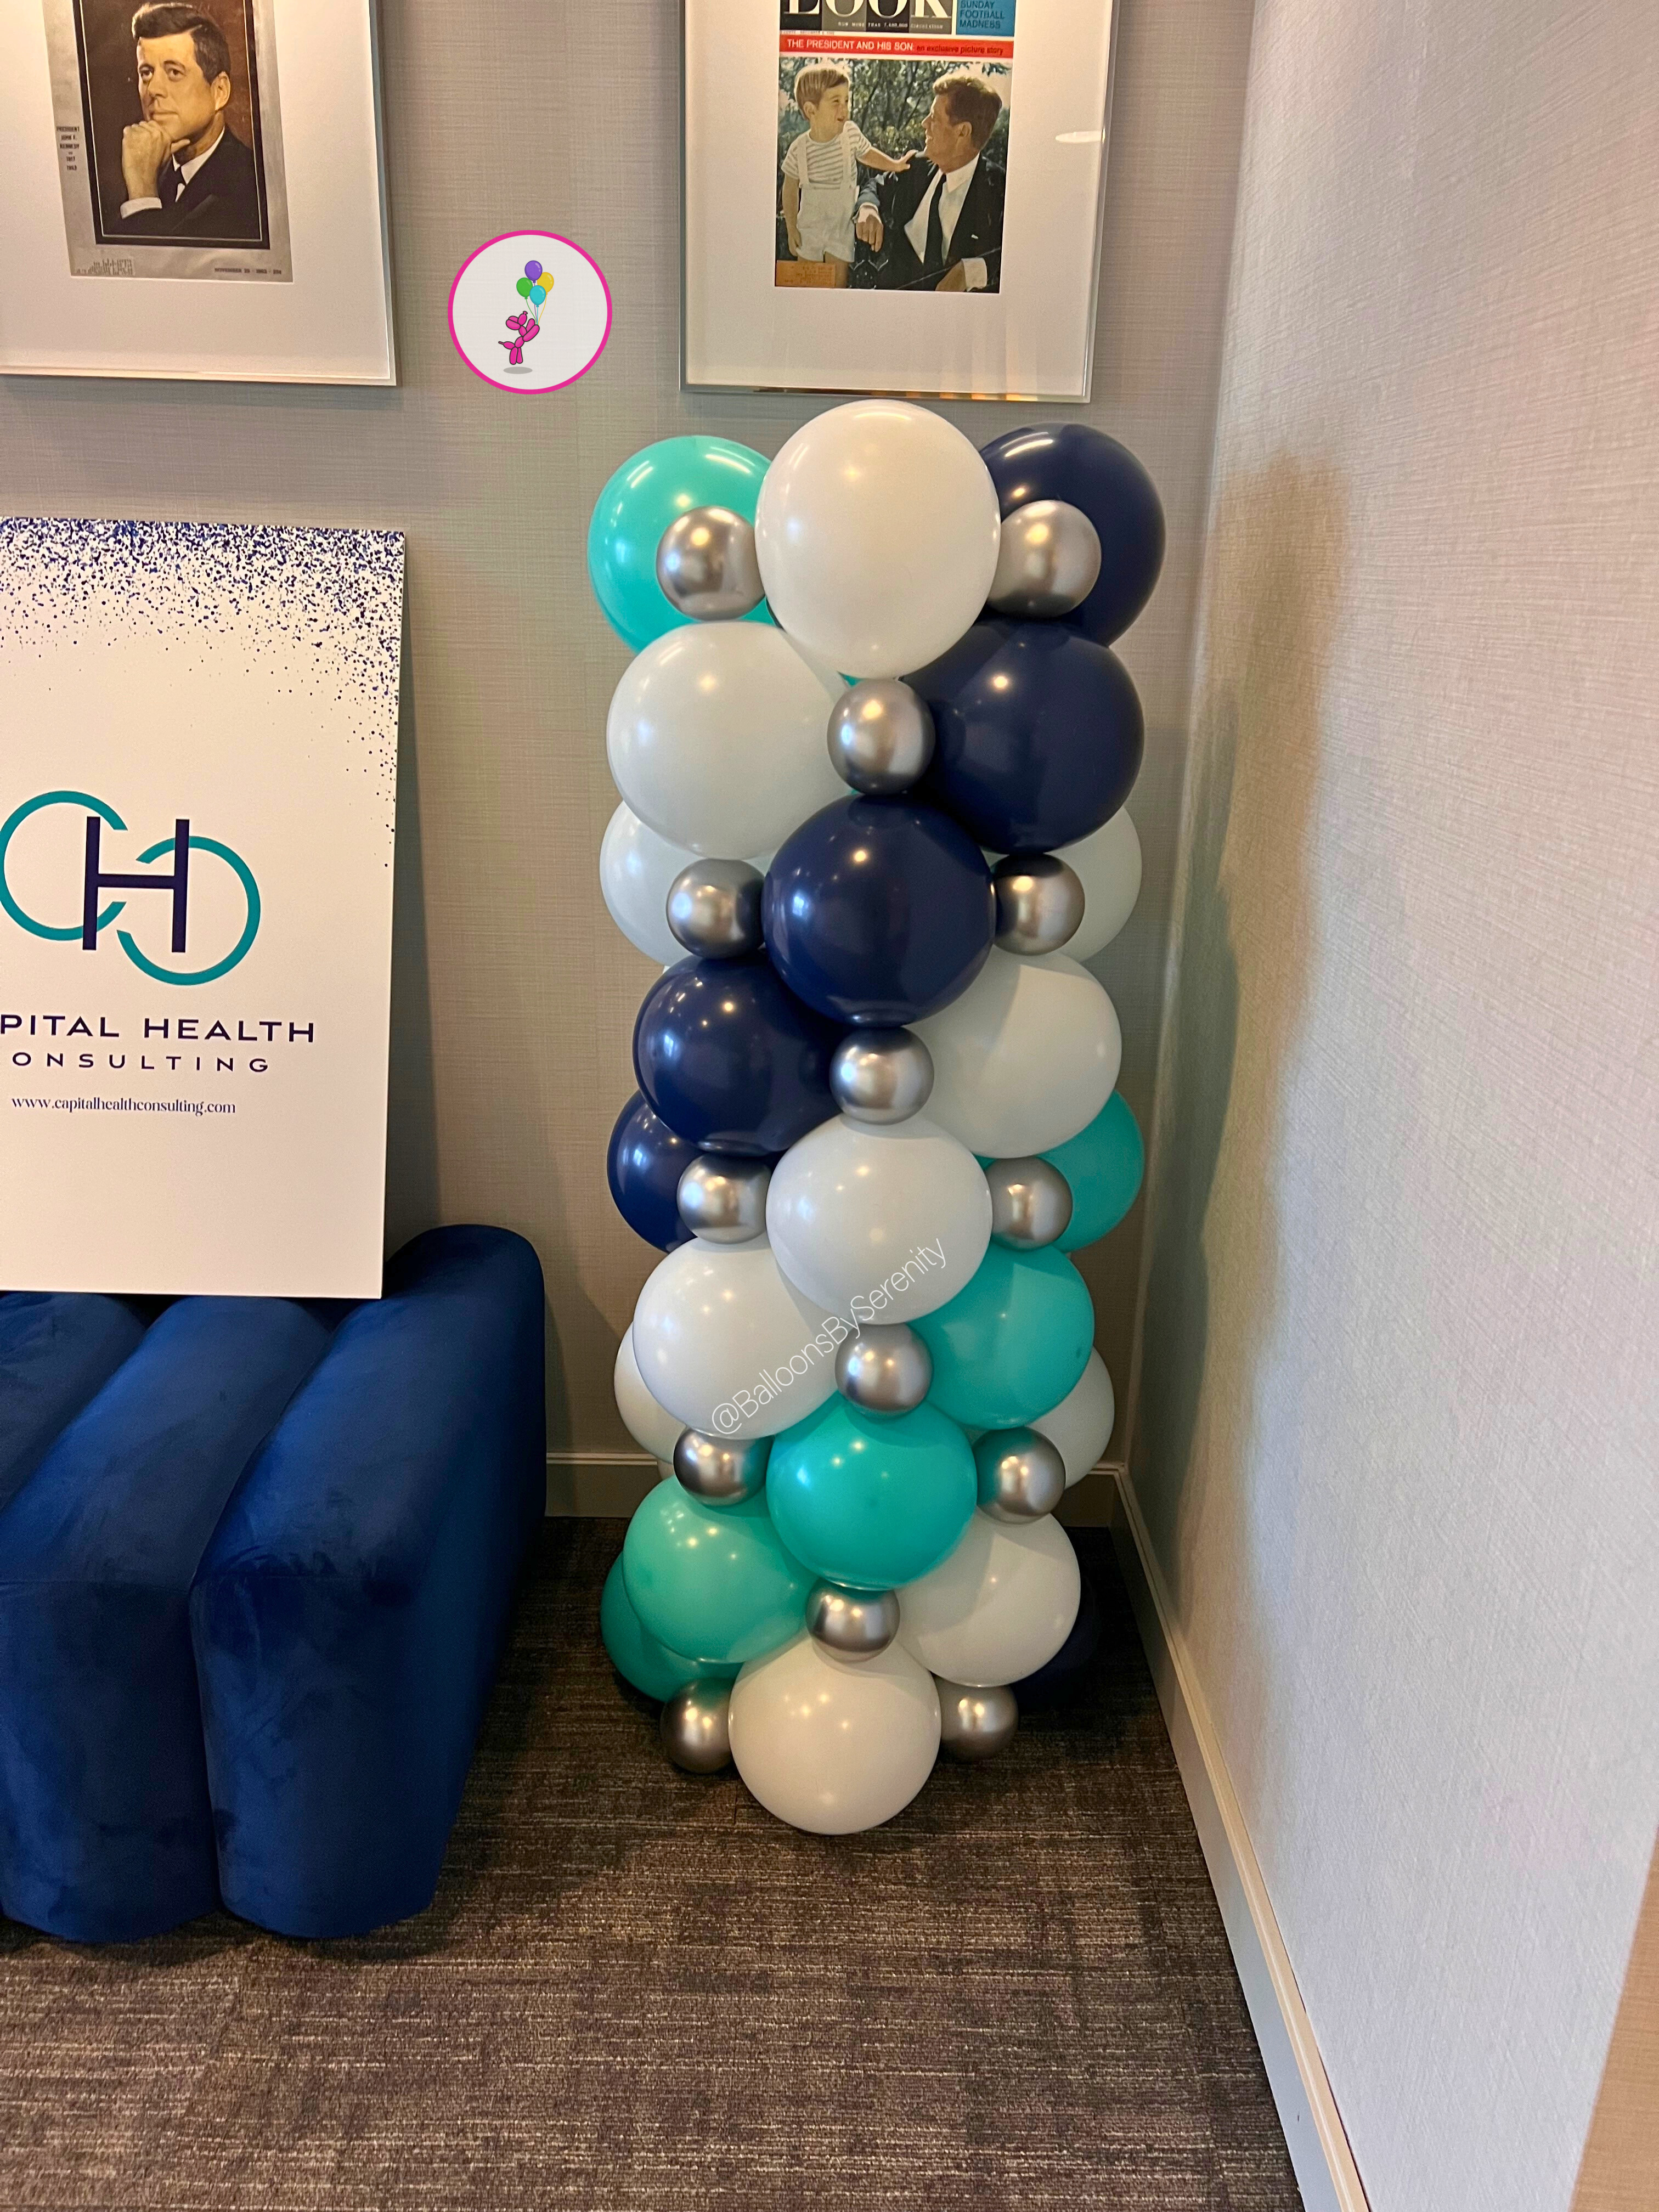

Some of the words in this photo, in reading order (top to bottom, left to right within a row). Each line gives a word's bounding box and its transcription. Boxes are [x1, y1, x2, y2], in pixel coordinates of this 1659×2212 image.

[960, 0, 995, 9] SUNDAY
[960, 9, 1005, 19] FOOTBALL
[959, 19, 1001, 29] MADNESS
[787, 39, 804, 48] THE
[806, 39, 854, 49] PRESIDENT
[856, 41, 874, 50] AND
[877, 41, 891, 50] HIS
[894, 42, 913, 51] SON
[927, 44, 959, 53] exclusive
[960, 45, 985, 54] picture
[986, 47, 1004, 55] story
[0, 1014, 120, 1037] PITAL
[144, 1018, 314, 1043] HEALTH
[12, 1051, 268, 1073] ONSULTING
[11, 1097, 236, 1116] www.capitalhealthconsulting.com
